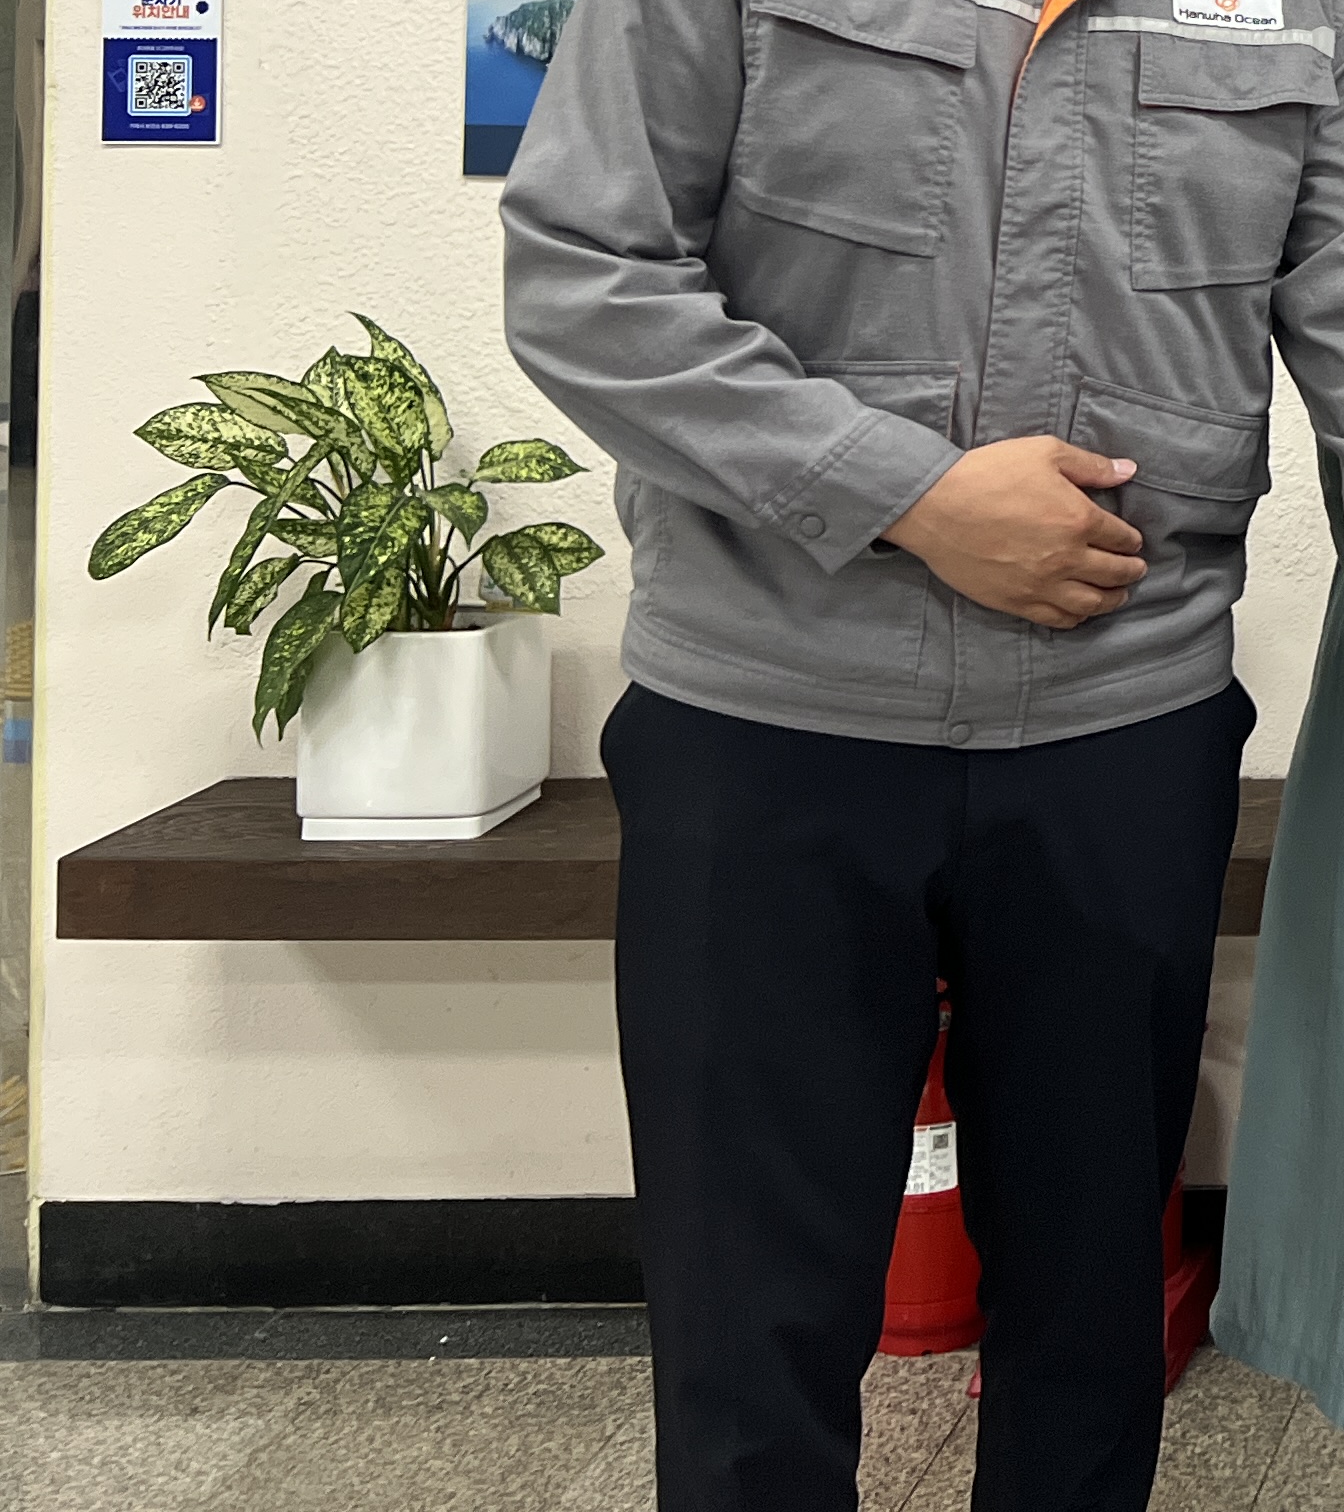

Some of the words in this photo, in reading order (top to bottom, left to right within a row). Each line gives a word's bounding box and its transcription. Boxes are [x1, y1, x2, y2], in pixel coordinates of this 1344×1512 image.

[132, 5, 190, 19] 위치안내
[1179, 8, 1231, 23] Hanwha
[1235, 14, 1277, 25] Ocean
